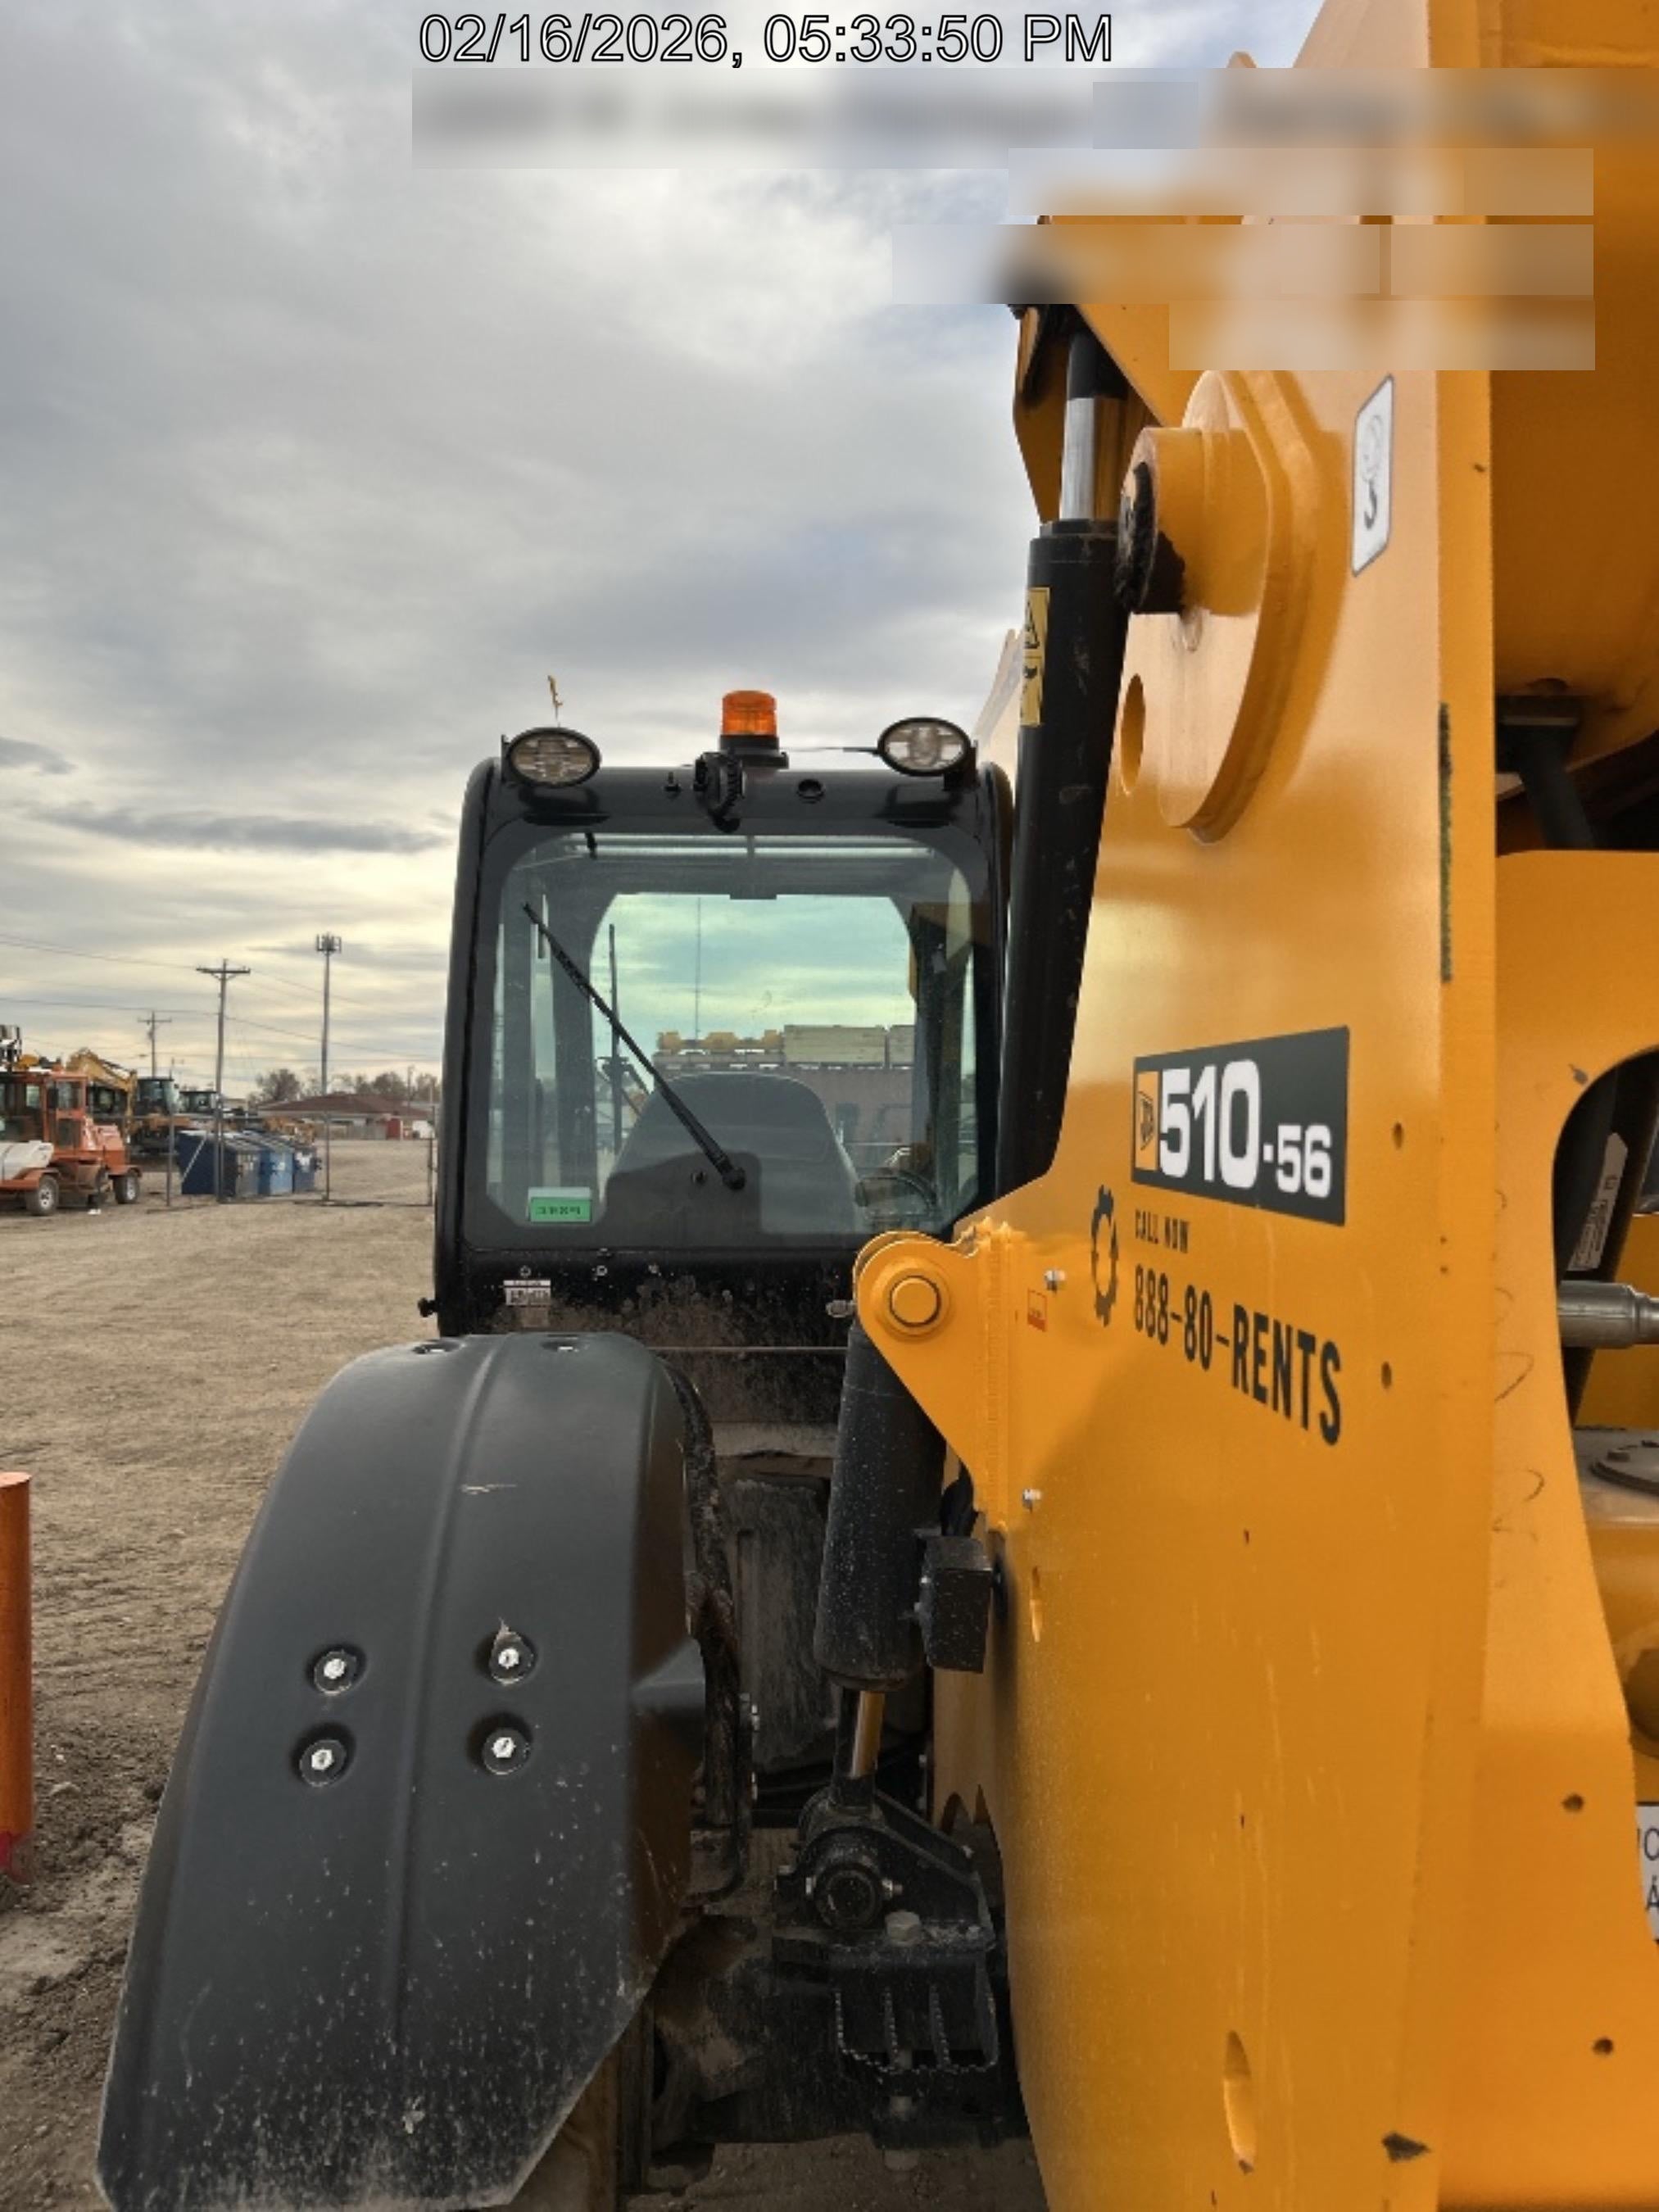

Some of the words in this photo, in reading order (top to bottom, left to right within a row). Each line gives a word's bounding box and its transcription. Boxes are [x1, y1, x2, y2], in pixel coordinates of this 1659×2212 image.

[1135, 1208, 1159, 1244] CALL
[1164, 1216, 1190, 1254] NOW
[1134, 1263, 1342, 1446] 888-80-RENTS
